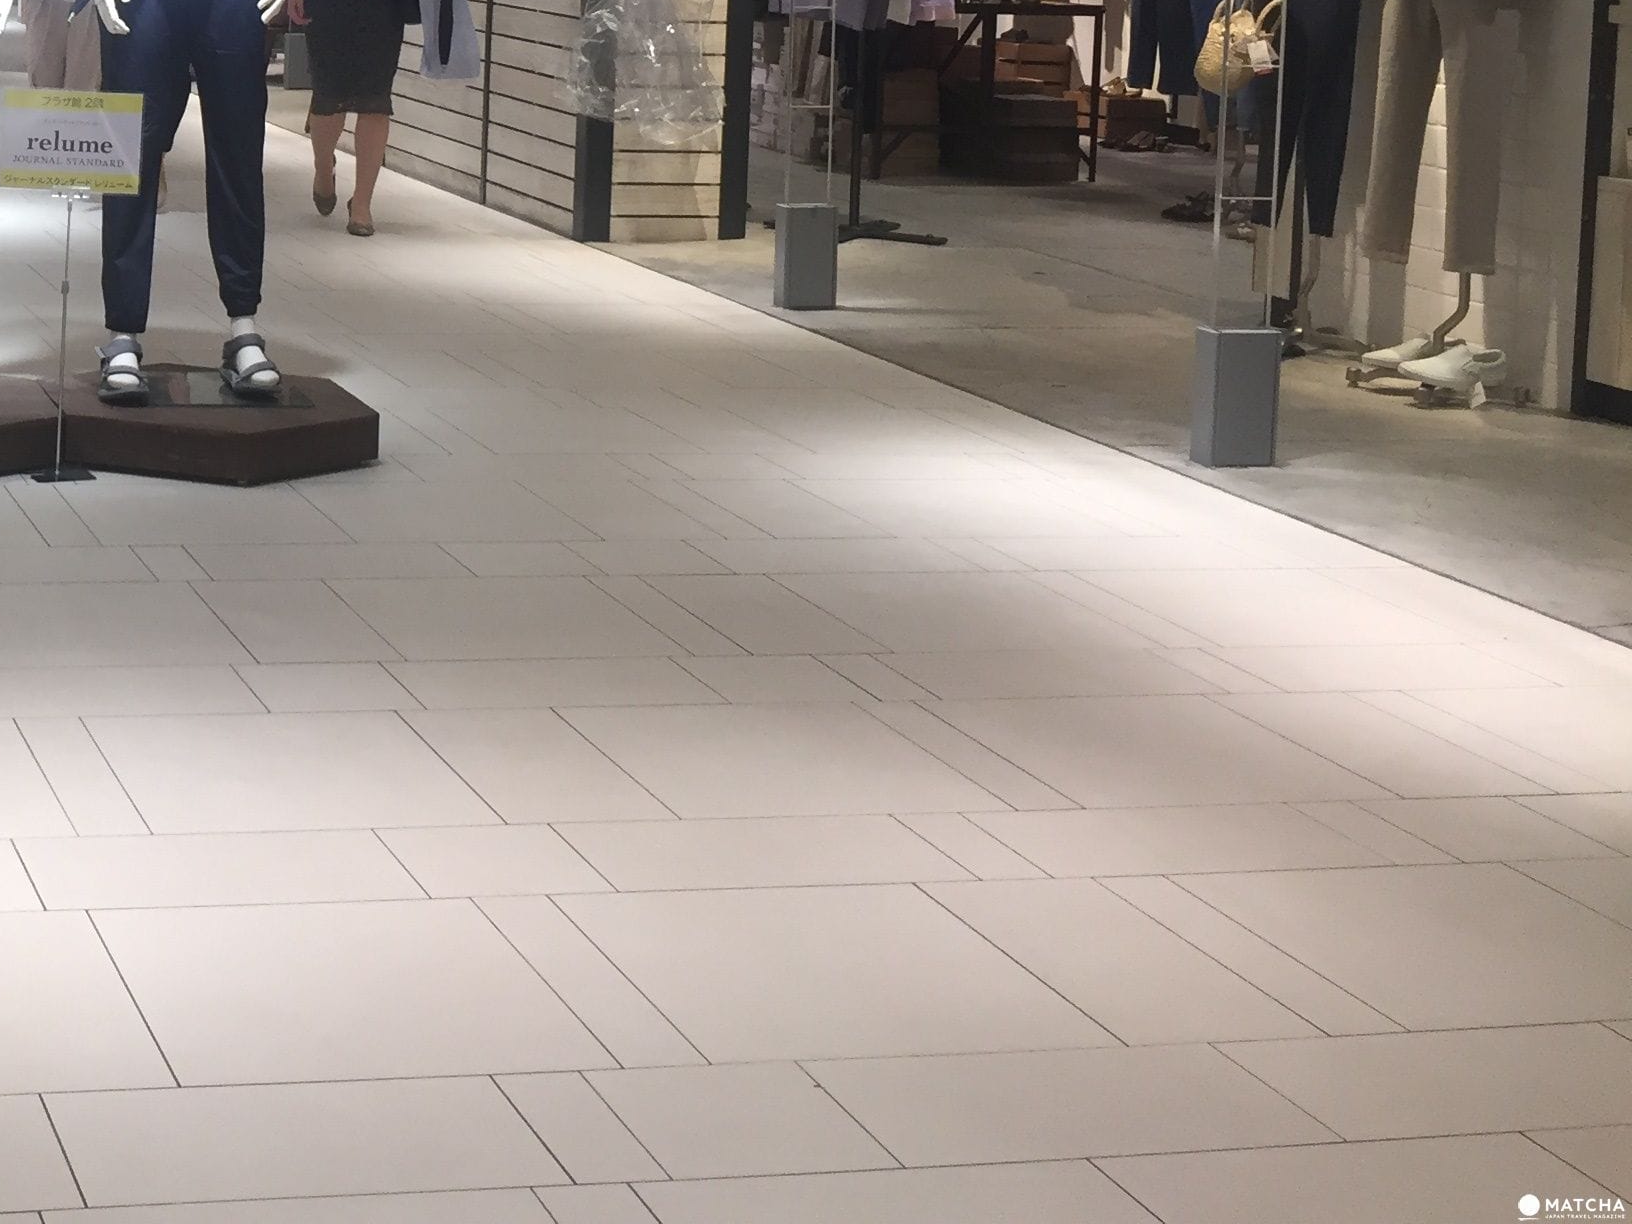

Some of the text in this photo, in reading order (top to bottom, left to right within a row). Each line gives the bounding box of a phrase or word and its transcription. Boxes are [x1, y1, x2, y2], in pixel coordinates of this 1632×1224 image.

[27, 130, 113, 154] relume
[13, 155, 125, 168] JOURNAL STANDARD
